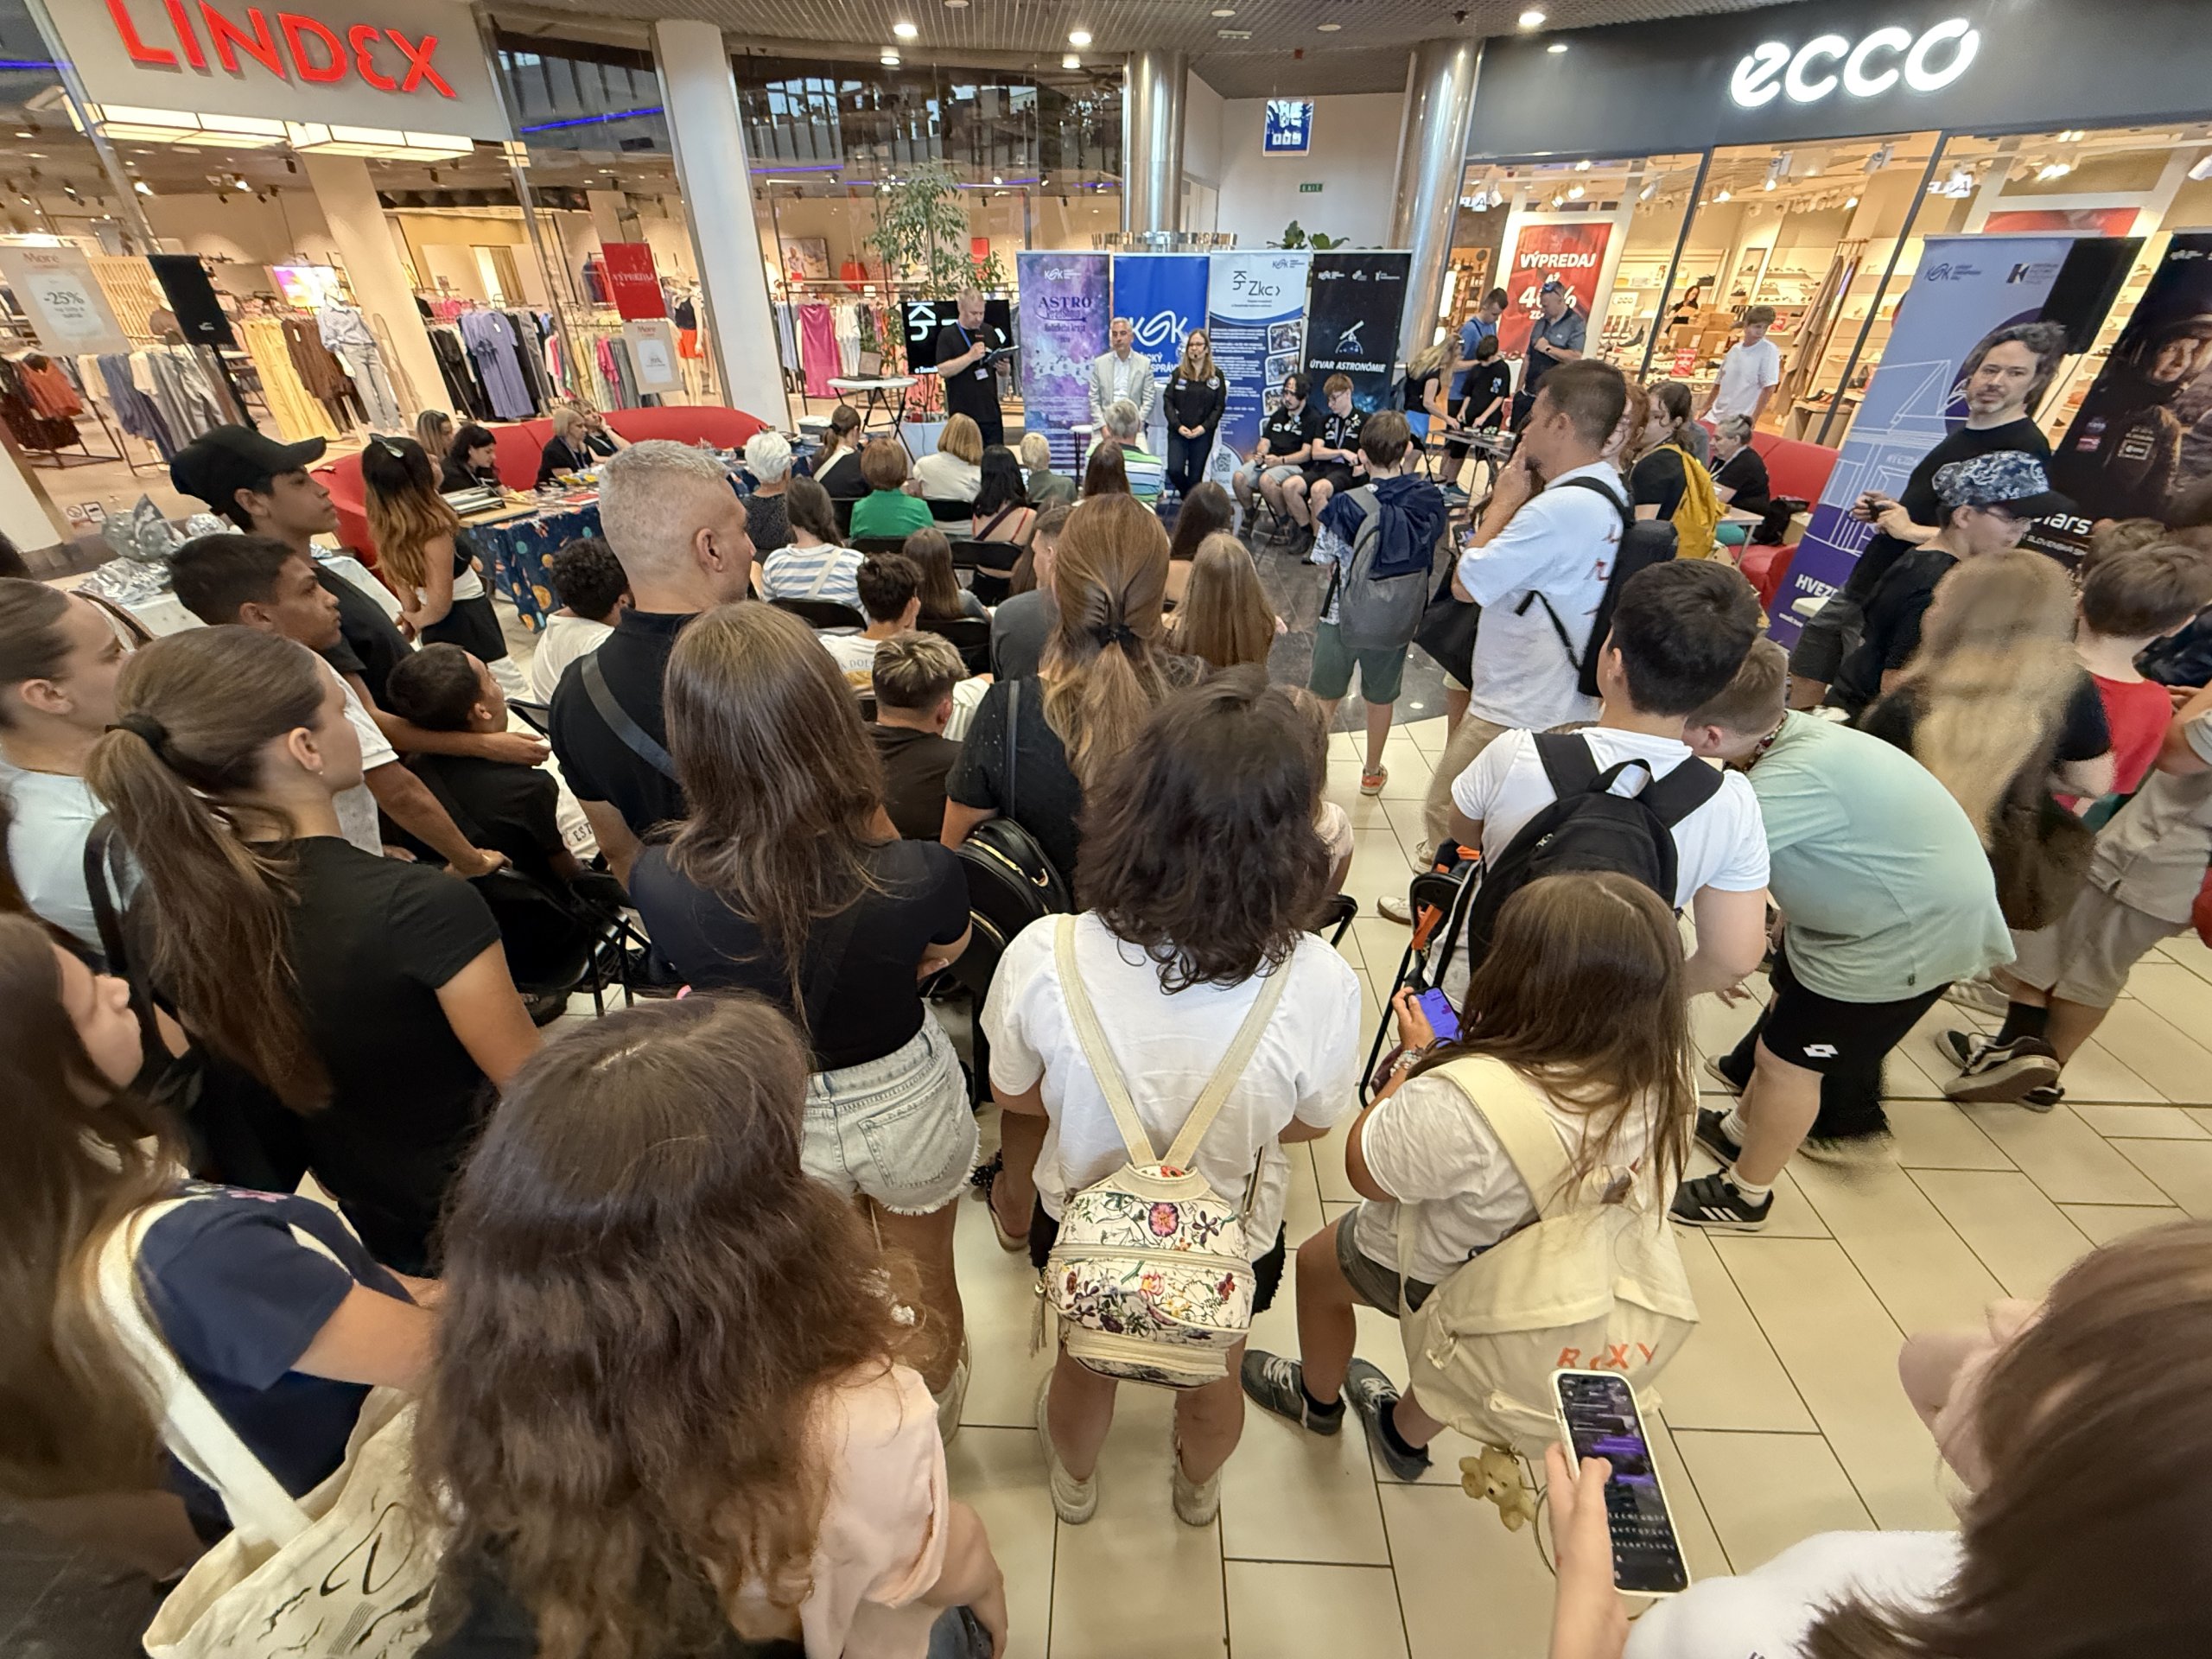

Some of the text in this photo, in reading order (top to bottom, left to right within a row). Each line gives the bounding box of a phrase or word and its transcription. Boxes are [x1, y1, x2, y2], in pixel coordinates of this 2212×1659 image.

[106, 0, 457, 98] LINDEX
[1731, 17, 1980, 108] ecco
[1520, 251, 1596, 268] VÝPREDAJ
[43, 290, 86, 305] -25%
[1039, 296, 1091, 310] ASTRO
[1309, 359, 1387, 373] ÚTVAR ASTRONÓMIE
[2034, 512, 2093, 535] ars
[849, 658, 875, 669] DOL
